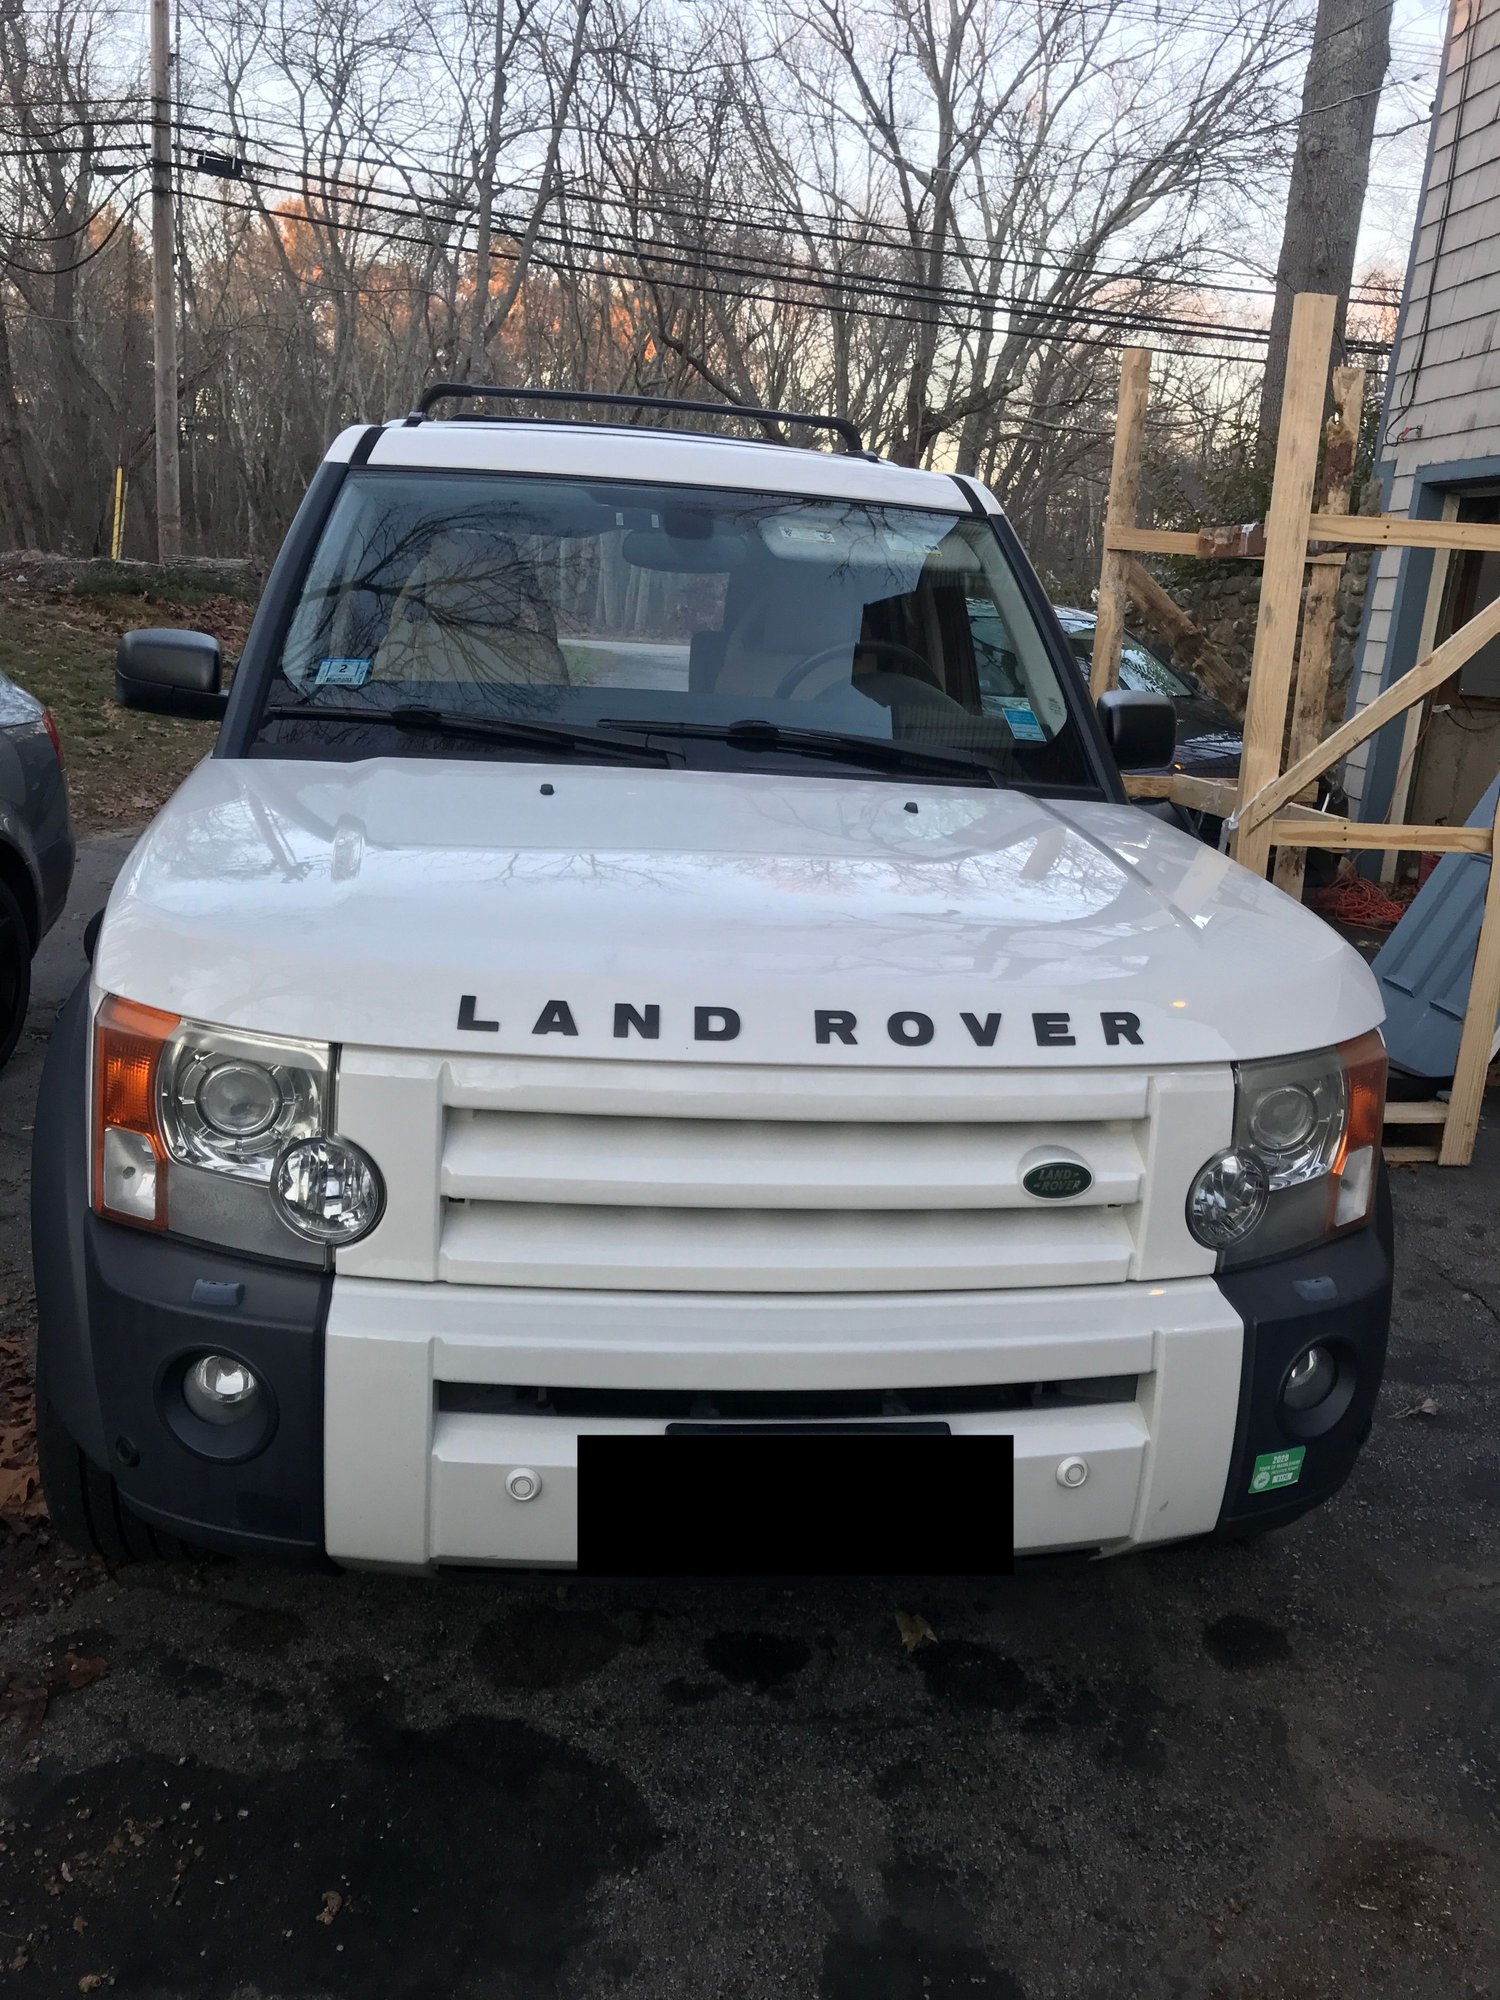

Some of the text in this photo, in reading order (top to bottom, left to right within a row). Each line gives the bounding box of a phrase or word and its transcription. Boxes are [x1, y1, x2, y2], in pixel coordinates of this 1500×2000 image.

[338, 664, 348, 673] 2
[457, 995, 1145, 1048] LAND ROVER
[1272, 1454, 1289, 1464] 2020
